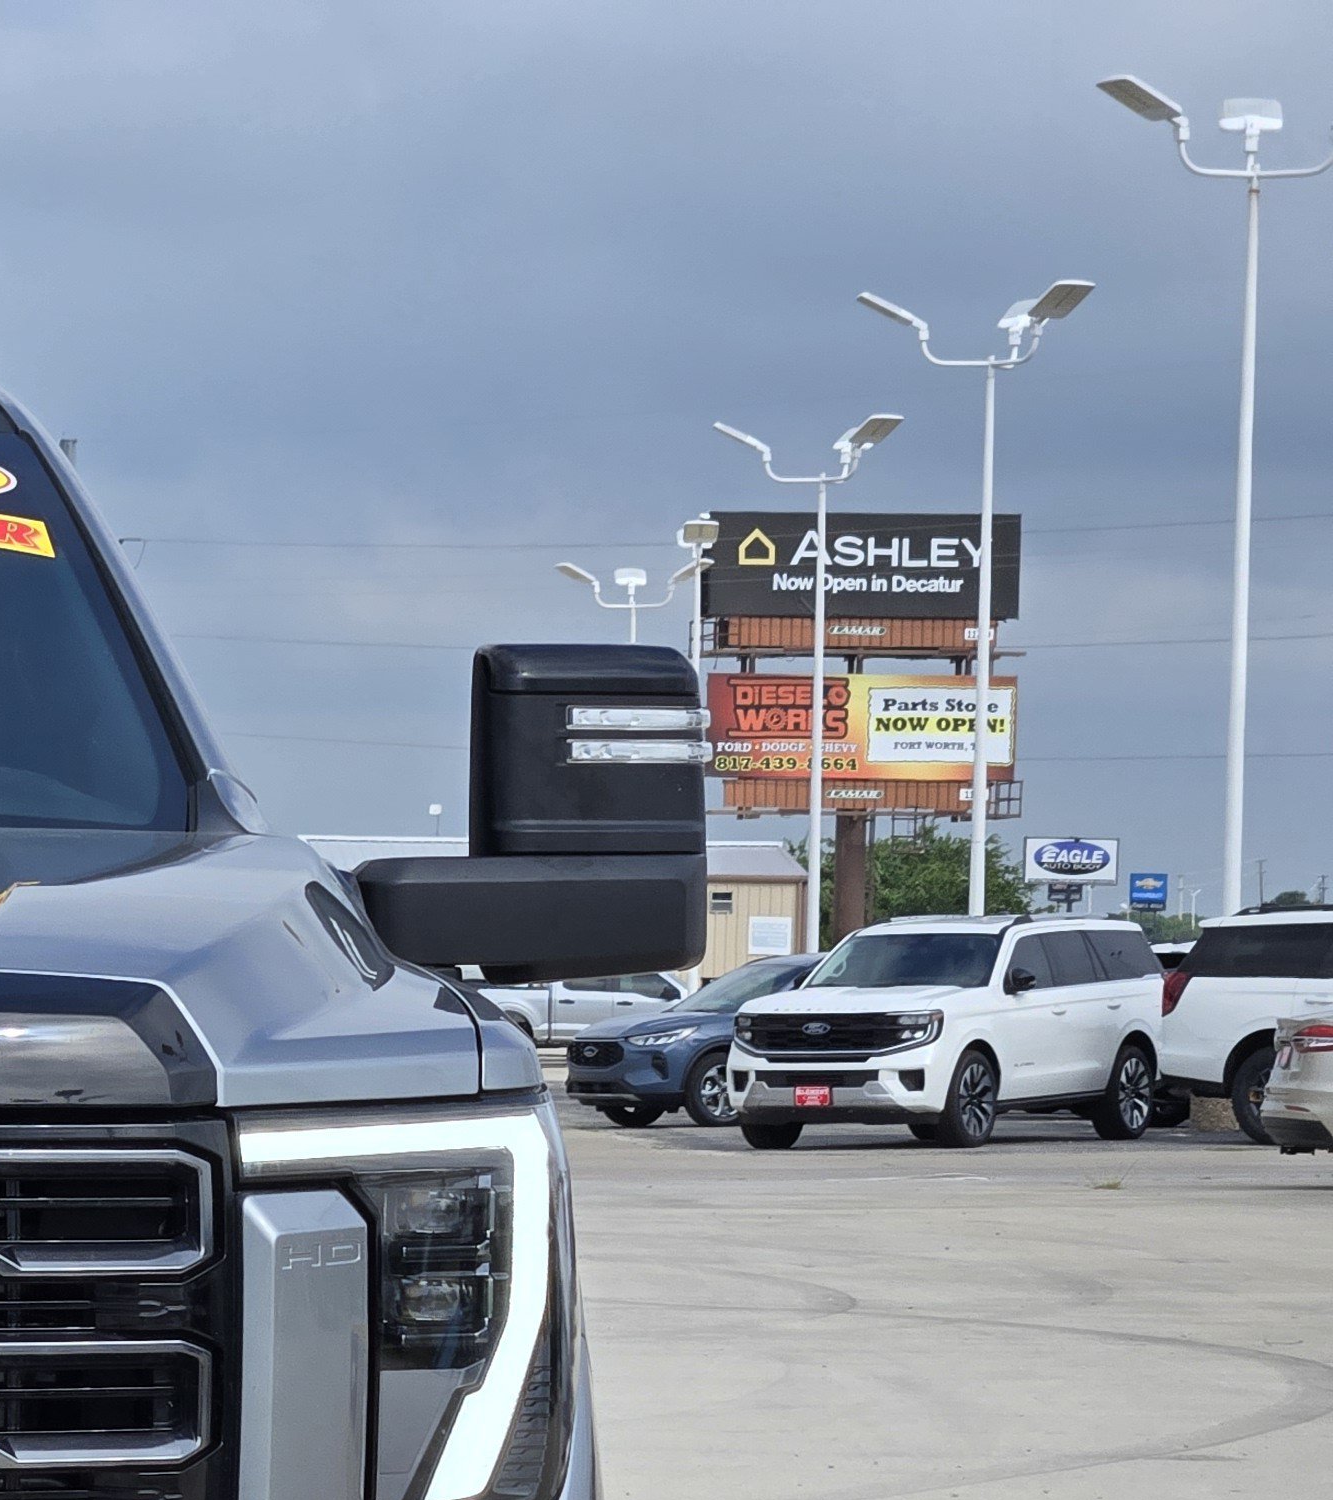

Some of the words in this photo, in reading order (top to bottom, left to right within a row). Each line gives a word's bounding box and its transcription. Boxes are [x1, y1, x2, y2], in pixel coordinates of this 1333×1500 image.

[790, 530, 993, 568] ASHLEY
[772, 573, 816, 591] Now
[870, 573, 888, 592] in
[892, 574, 964, 593] Decatur
[832, 625, 881, 635] LAMAR
[882, 698, 939, 713] Parts
[944, 698, 999, 713] Stoe
[875, 717, 930, 732] NOW
[716, 742, 752, 753] FORD
[761, 742, 807, 753] DODGE
[893, 741, 923, 750] FORT
[1040, 845, 1105, 864] EAGLE
[281, 1242, 362, 1271] HD
